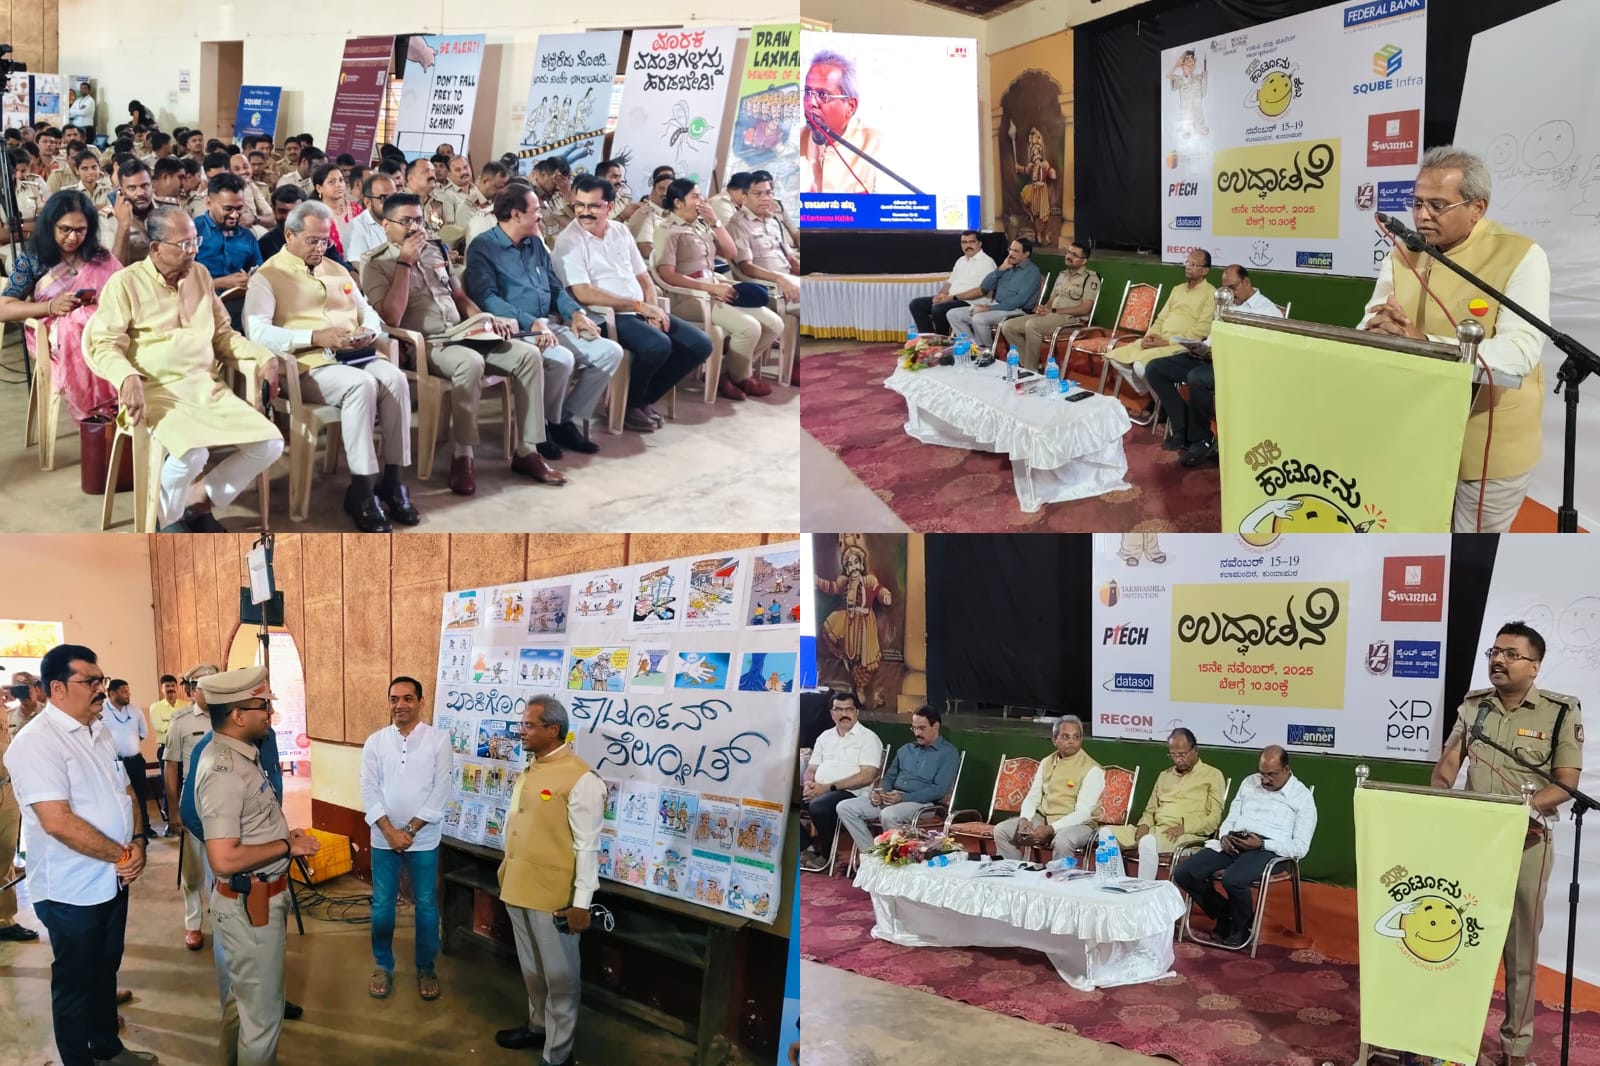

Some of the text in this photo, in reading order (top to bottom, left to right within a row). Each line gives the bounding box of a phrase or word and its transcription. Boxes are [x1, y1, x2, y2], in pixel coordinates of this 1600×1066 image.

[1347, 3, 1388, 23] FEDERAL
[439, 41, 480, 54] BE ALERT!
[652, 31, 705, 51] ಮಾರಕ
[756, 31, 792, 48] DRAW
[633, 46, 725, 75] ವದಂತಿಗಳನ್ನು
[753, 50, 800, 68] LAXMA
[436, 74, 475, 87] DON'T FALL
[643, 70, 714, 91] ಹರಡಬೇಡಿ!
[1353, 76, 1423, 94] SQUBE Infra
[433, 89, 463, 101] PREY TO
[430, 103, 464, 116] PHISHING
[428, 117, 456, 130] SCAMS!
[1245, 123, 1278, 136] ನವೆಂಬರ್
[1371, 140, 1414, 151] Swarna
[1217, 143, 1335, 201] ಉದ್ಘಾಟನೆ
[1291, 205, 1317, 215] 2025
[1176, 217, 1201, 227] datasol
[1255, 459, 1361, 508] ಕಾರ್ಟೂನು
[1219, 556, 1264, 568] ನವೆಂಬರ್
[1388, 589, 1437, 603] Swarna
[1178, 587, 1340, 656] ಉದ್ಘಾಟನೆ
[1198, 661, 1223, 674] 15ನೇ
[1283, 666, 1314, 676] 2025
[1116, 674, 1153, 688] datasol
[1251, 680, 1289, 698] 10.30ಕ್ಕೆ
[446, 688, 733, 734] ಖಾಕಿಗೊಂ ಕಾರ್ಟೂನ್
[1388, 699, 1433, 722] XP
[1100, 713, 1153, 727] RECON
[1290, 726, 1334, 742] Manner
[1386, 723, 1430, 743] pen
[597, 731, 771, 786] ಸೆಲ್ಯೂಟ್
[1388, 875, 1461, 902] ಕಾರ್ಟೂನು
